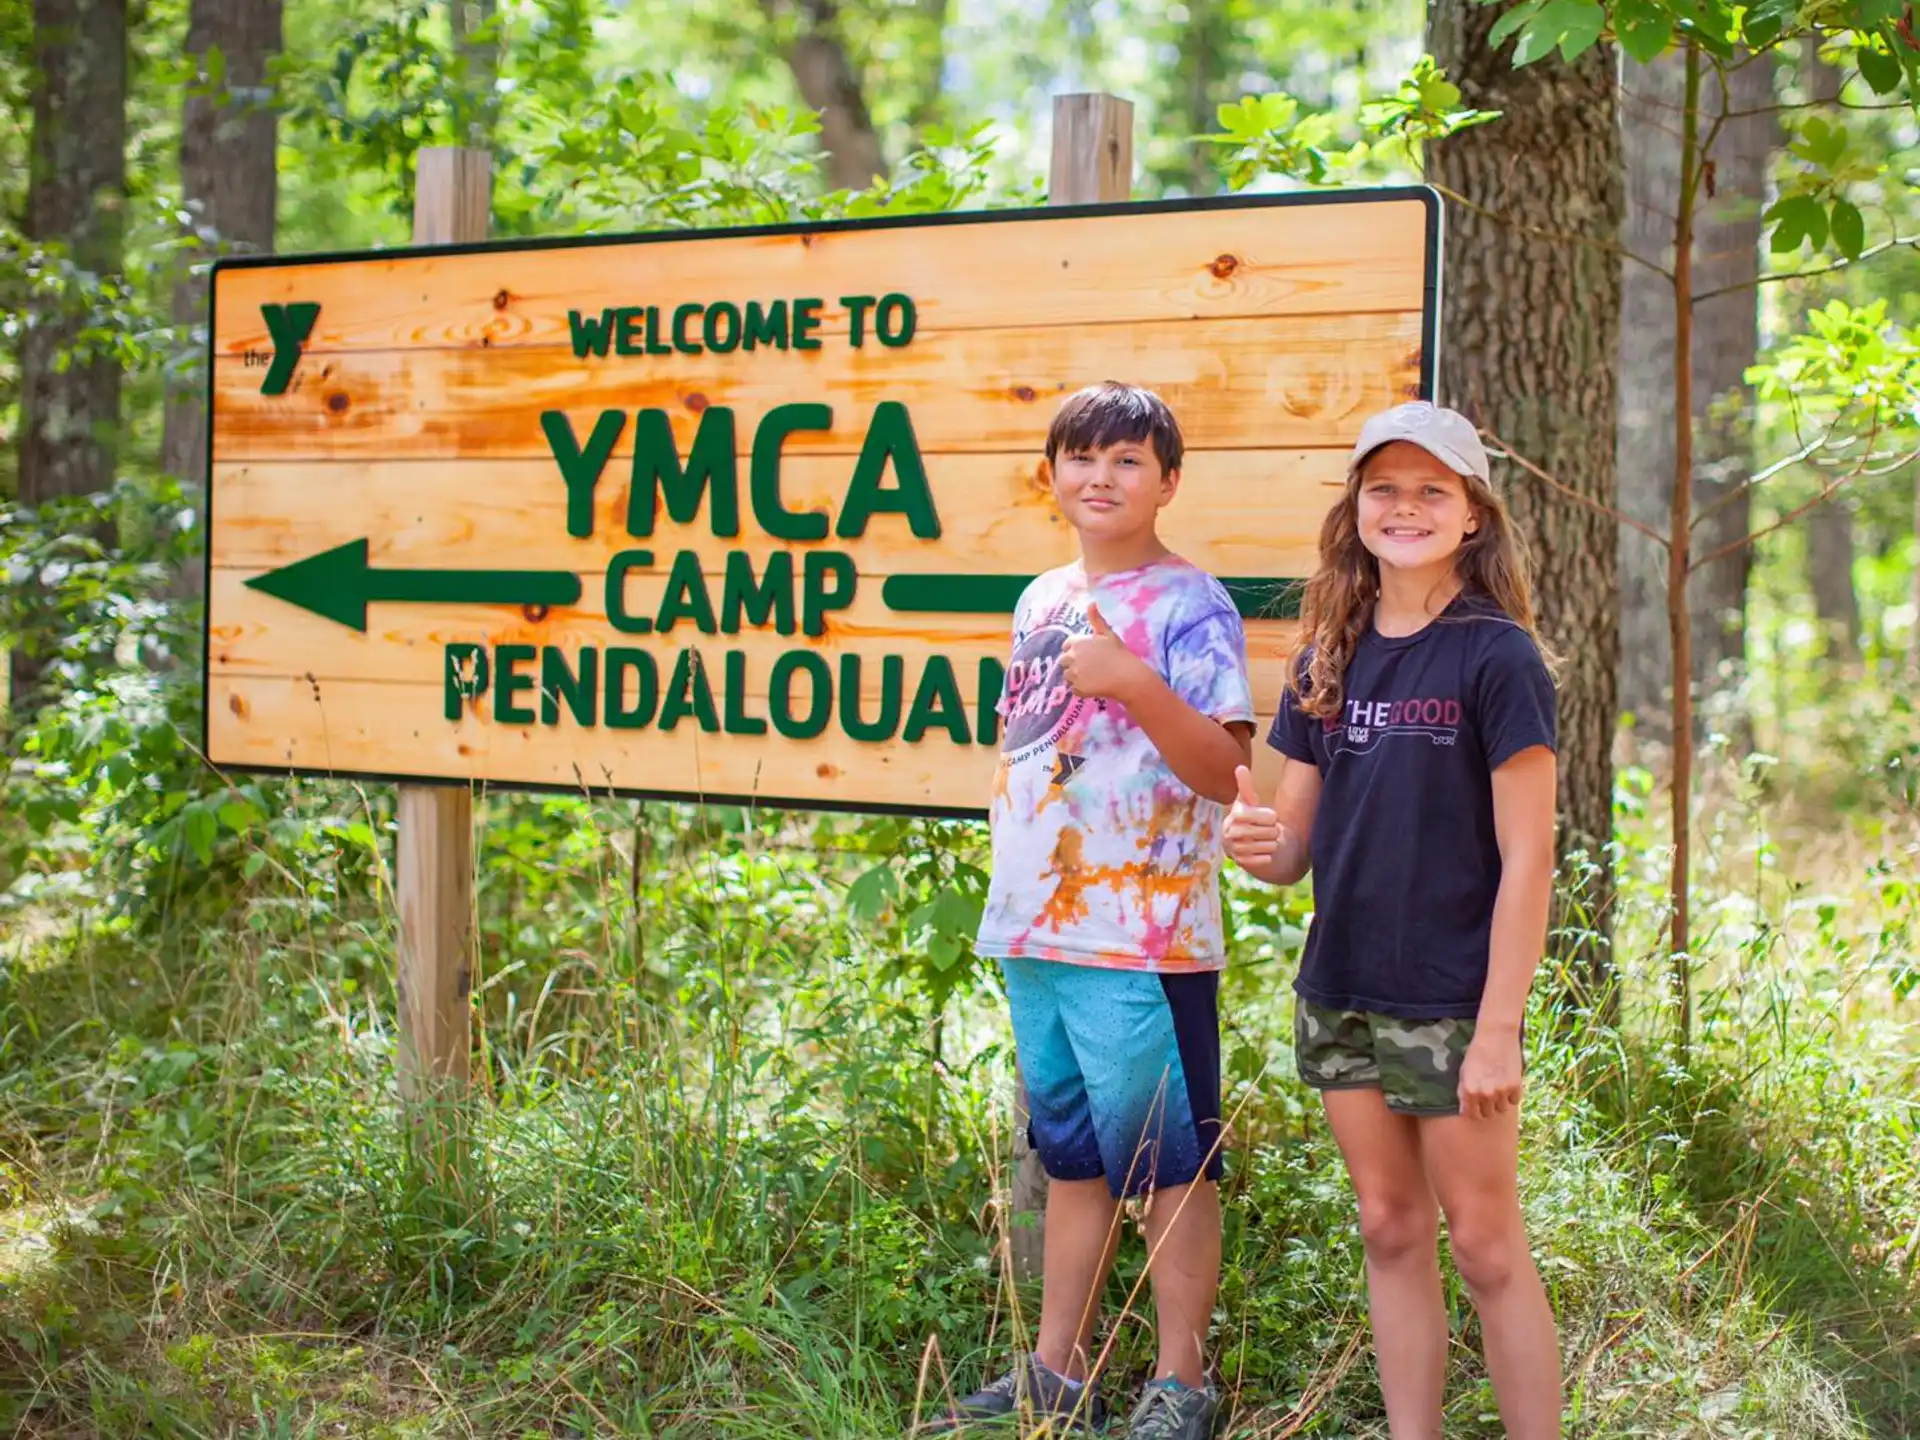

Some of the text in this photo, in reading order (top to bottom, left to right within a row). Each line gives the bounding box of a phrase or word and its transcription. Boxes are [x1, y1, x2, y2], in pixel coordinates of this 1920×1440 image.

[244, 349, 269, 368] the
[568, 292, 918, 359] WELCOME TO
[540, 400, 942, 542] YMCA
[604, 549, 858, 637] CAMP
[1009, 655, 1062, 692] DAY
